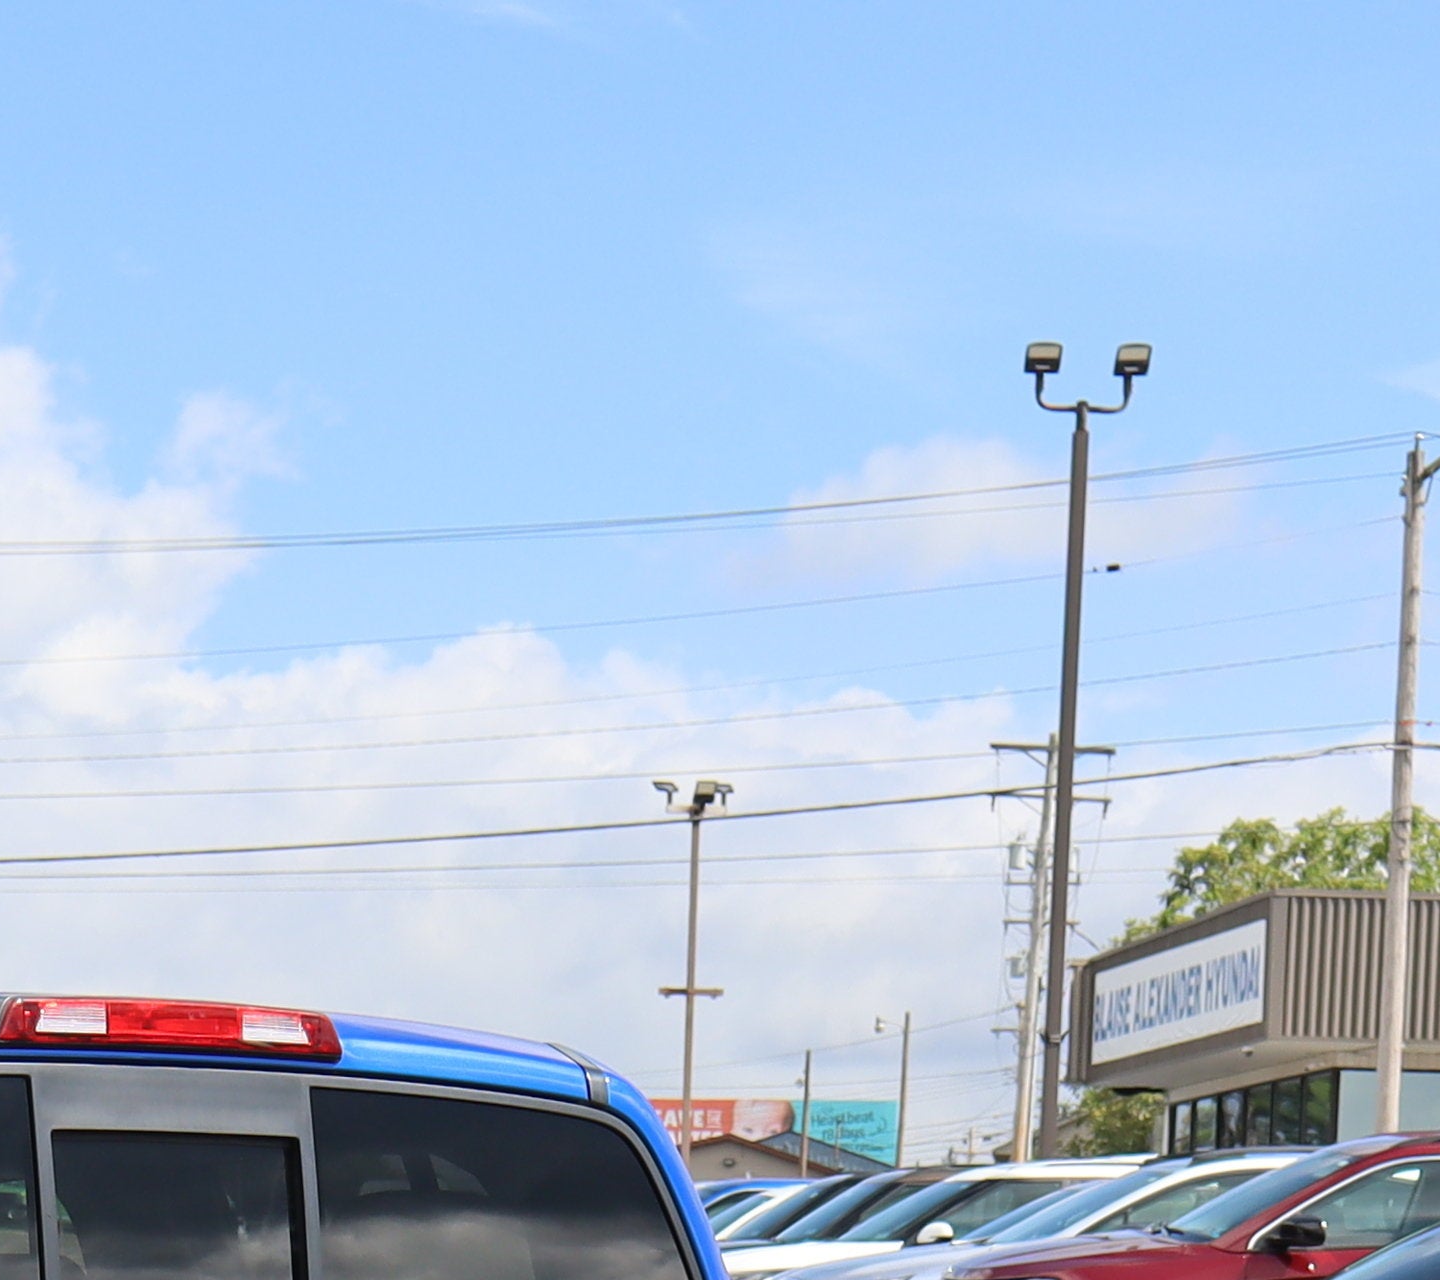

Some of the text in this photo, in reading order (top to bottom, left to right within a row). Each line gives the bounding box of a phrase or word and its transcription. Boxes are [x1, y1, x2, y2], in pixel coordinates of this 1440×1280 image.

[1094, 945, 1261, 1042] BLAISE ALEXANDER HYUNDAI
